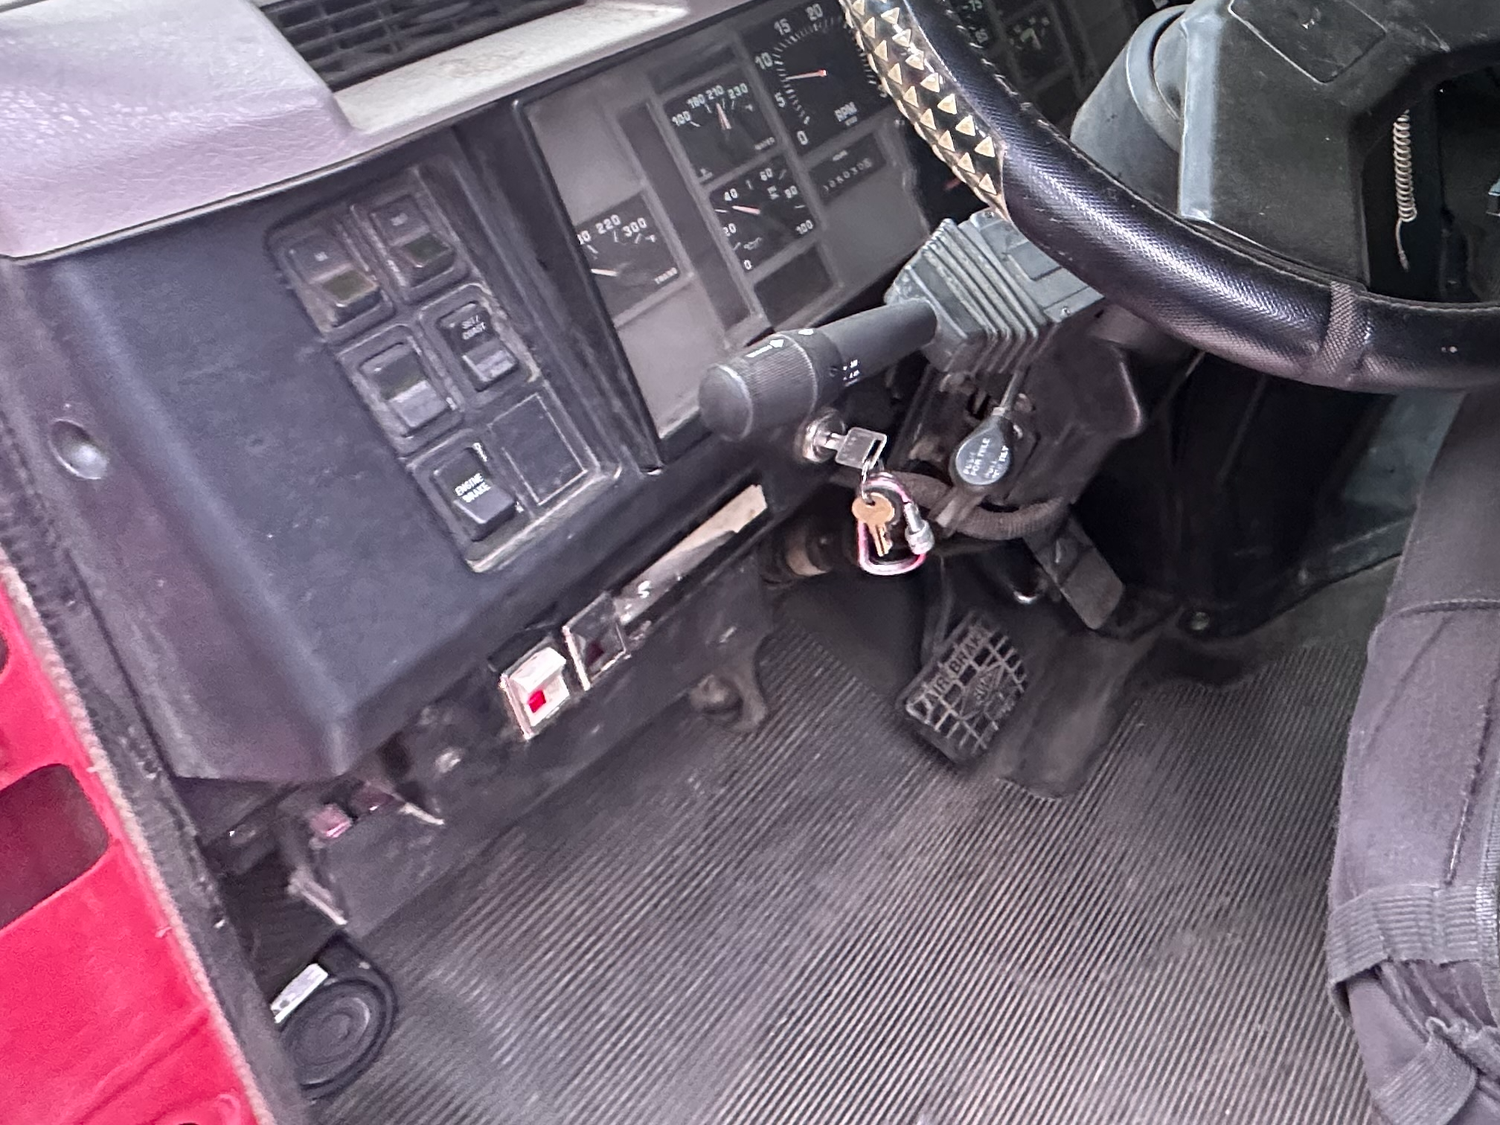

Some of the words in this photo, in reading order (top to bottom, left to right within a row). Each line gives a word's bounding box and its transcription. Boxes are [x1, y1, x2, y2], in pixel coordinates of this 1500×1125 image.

[805, 3, 823, 22] 20
[774, 18, 791, 36] 15
[755, 52, 773, 70] 10
[705, 85, 724, 100] 210
[727, 83, 748, 100] 230
[774, 92, 786, 108] 5
[672, 110, 691, 127] 100
[834, 101, 857, 122] RPM
[797, 130, 809, 146] 0
[760, 167, 773, 181] 60
[724, 188, 738, 202] 40
[595, 214, 621, 235] 220
[622, 217, 647, 238] 300
[796, 219, 814, 235] 100
[743, 259, 753, 271] 0
[455, 473, 484, 497] ENGINE
[463, 480, 491, 503] BRAKE
[924, 676, 950, 707] AIR
